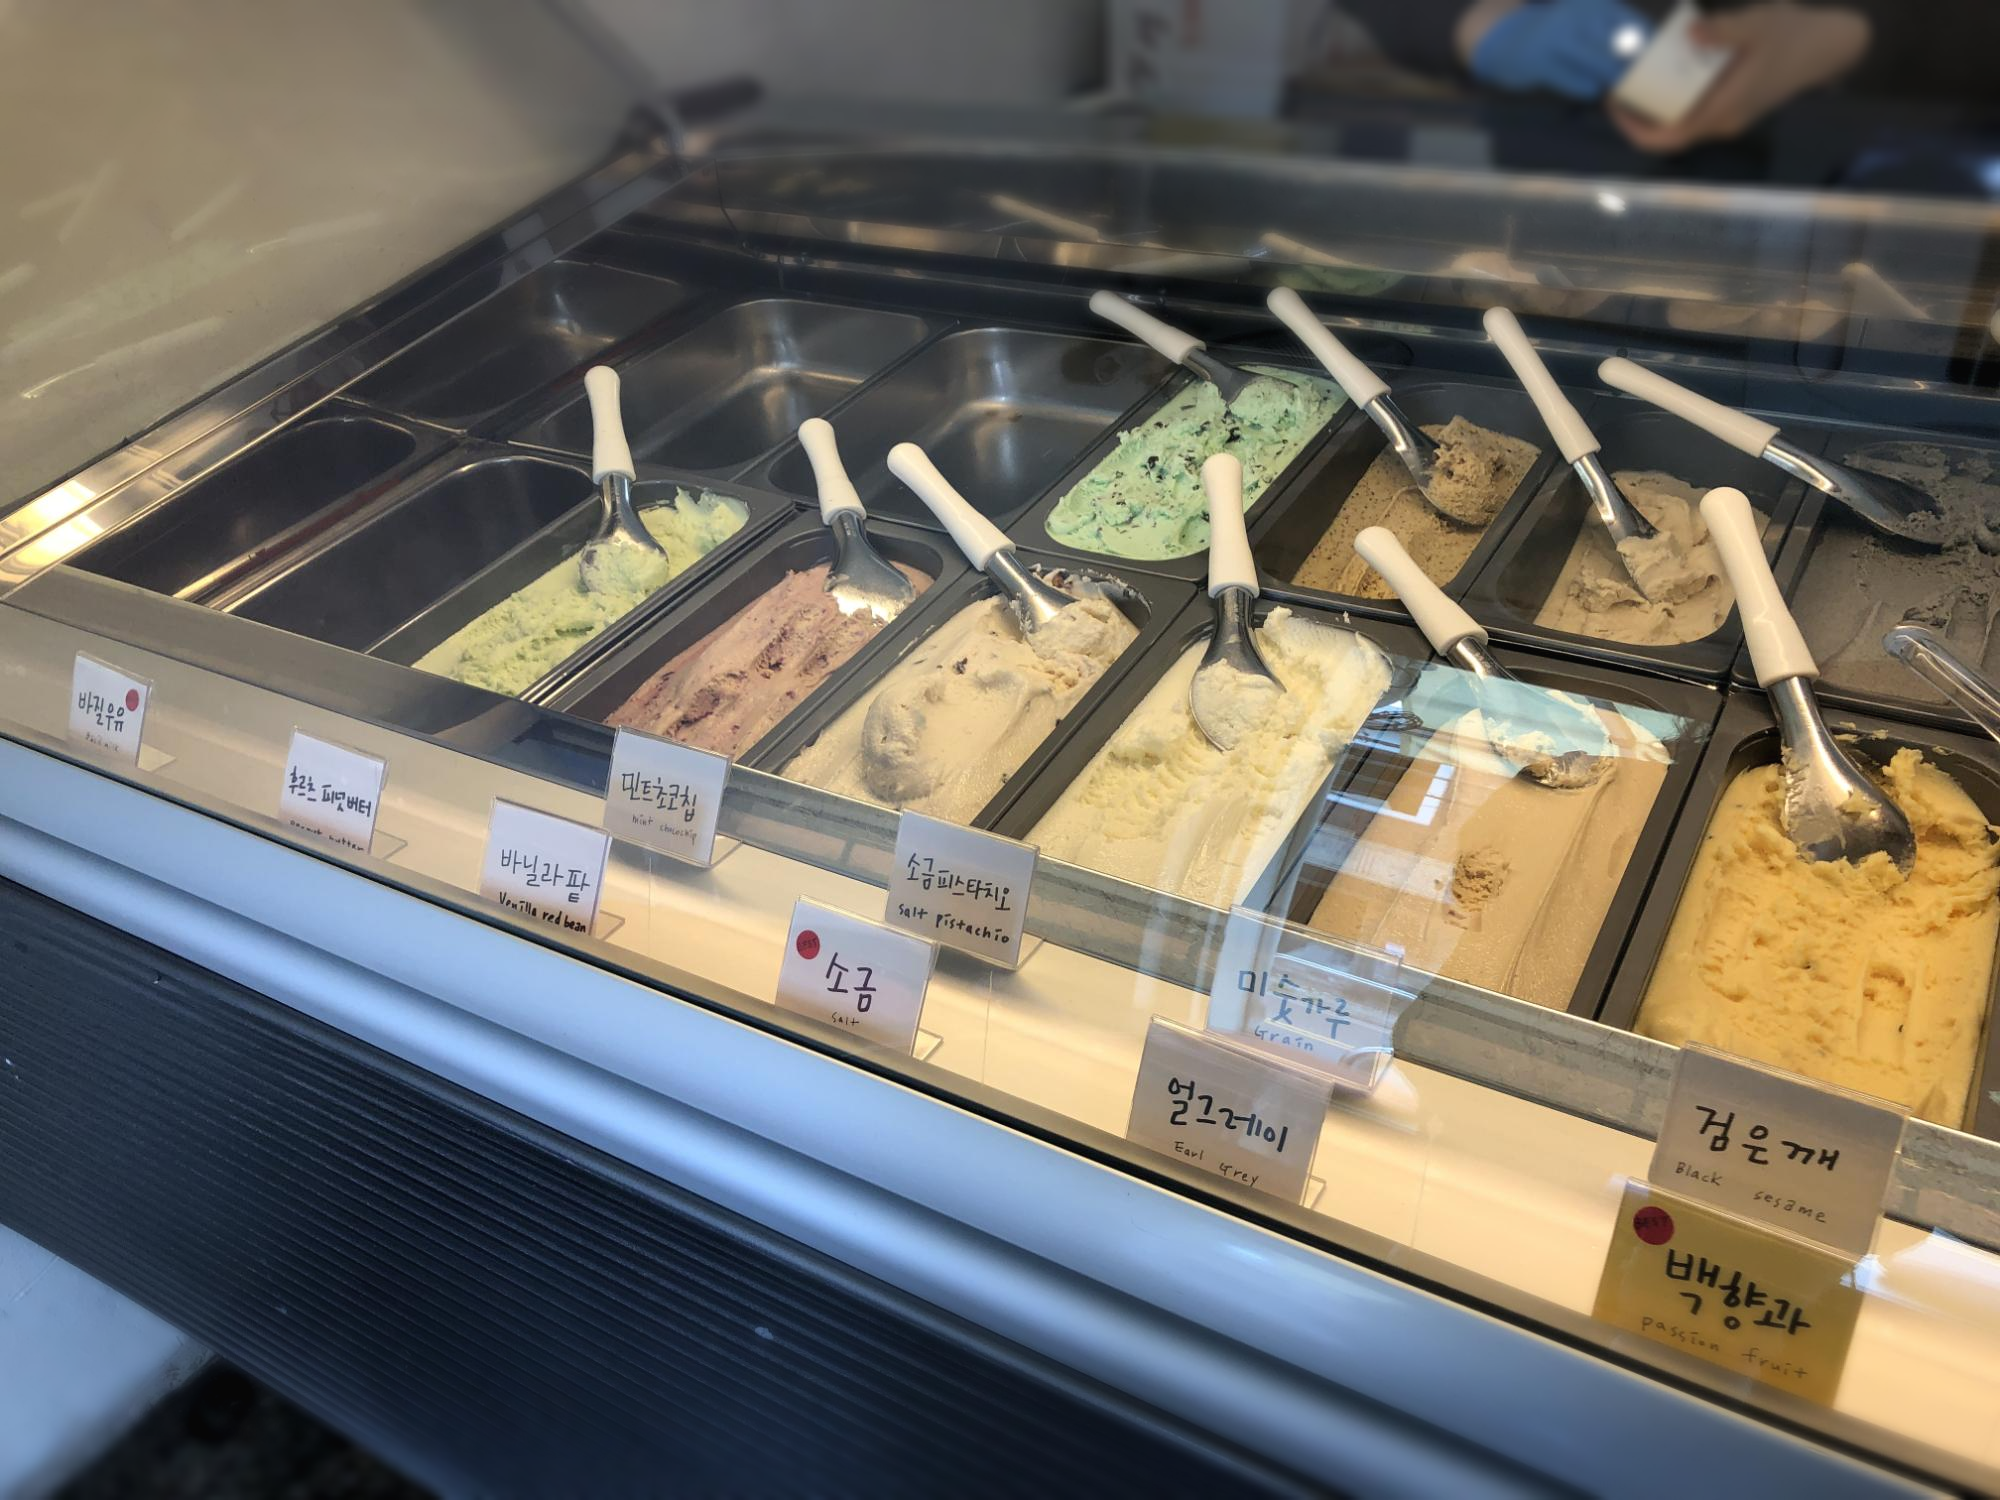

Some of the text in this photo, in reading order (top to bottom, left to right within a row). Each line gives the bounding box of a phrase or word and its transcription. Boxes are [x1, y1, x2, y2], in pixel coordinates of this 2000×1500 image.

[621, 771, 698, 823] 민트초코칩
[907, 852, 1011, 912] 소금피스타치오
[825, 951, 878, 1013] 소금
[1237, 970, 1351, 1040] 미숫가루
[1254, 1024, 1315, 1051] Grain
[1167, 1076, 1289, 1153] 얼그레이
[1695, 1104, 1841, 1172] 검은깨
[1173, 1140, 1260, 1188] Earl Grey
[1674, 1161, 1725, 1187] Black
[1664, 1248, 1812, 1336] 백향과
[1741, 1346, 1809, 1380] fruit
